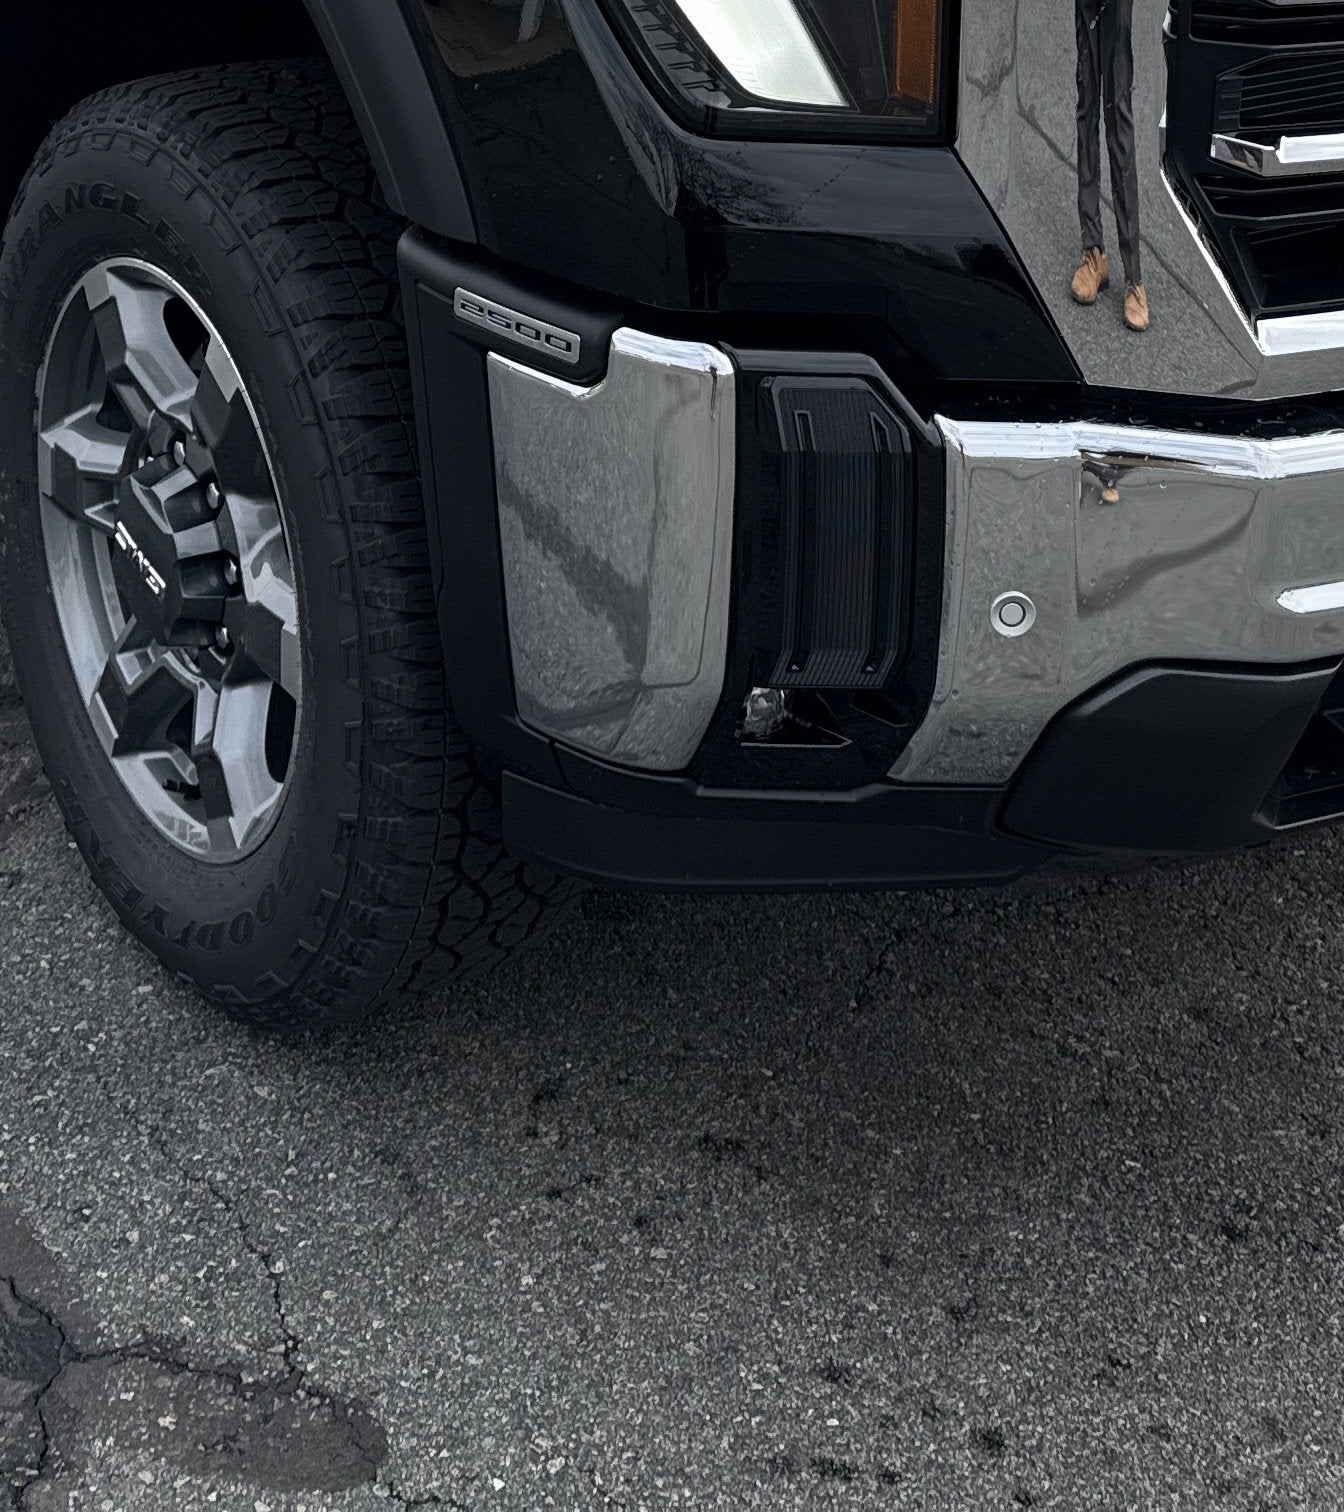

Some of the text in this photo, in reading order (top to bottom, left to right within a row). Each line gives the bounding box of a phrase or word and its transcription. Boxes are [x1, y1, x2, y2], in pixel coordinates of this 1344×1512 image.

[0, 180, 214, 318] WRANGLER
[460, 299, 572, 353] 2500
[67, 798, 299, 950] GOODYEAR
